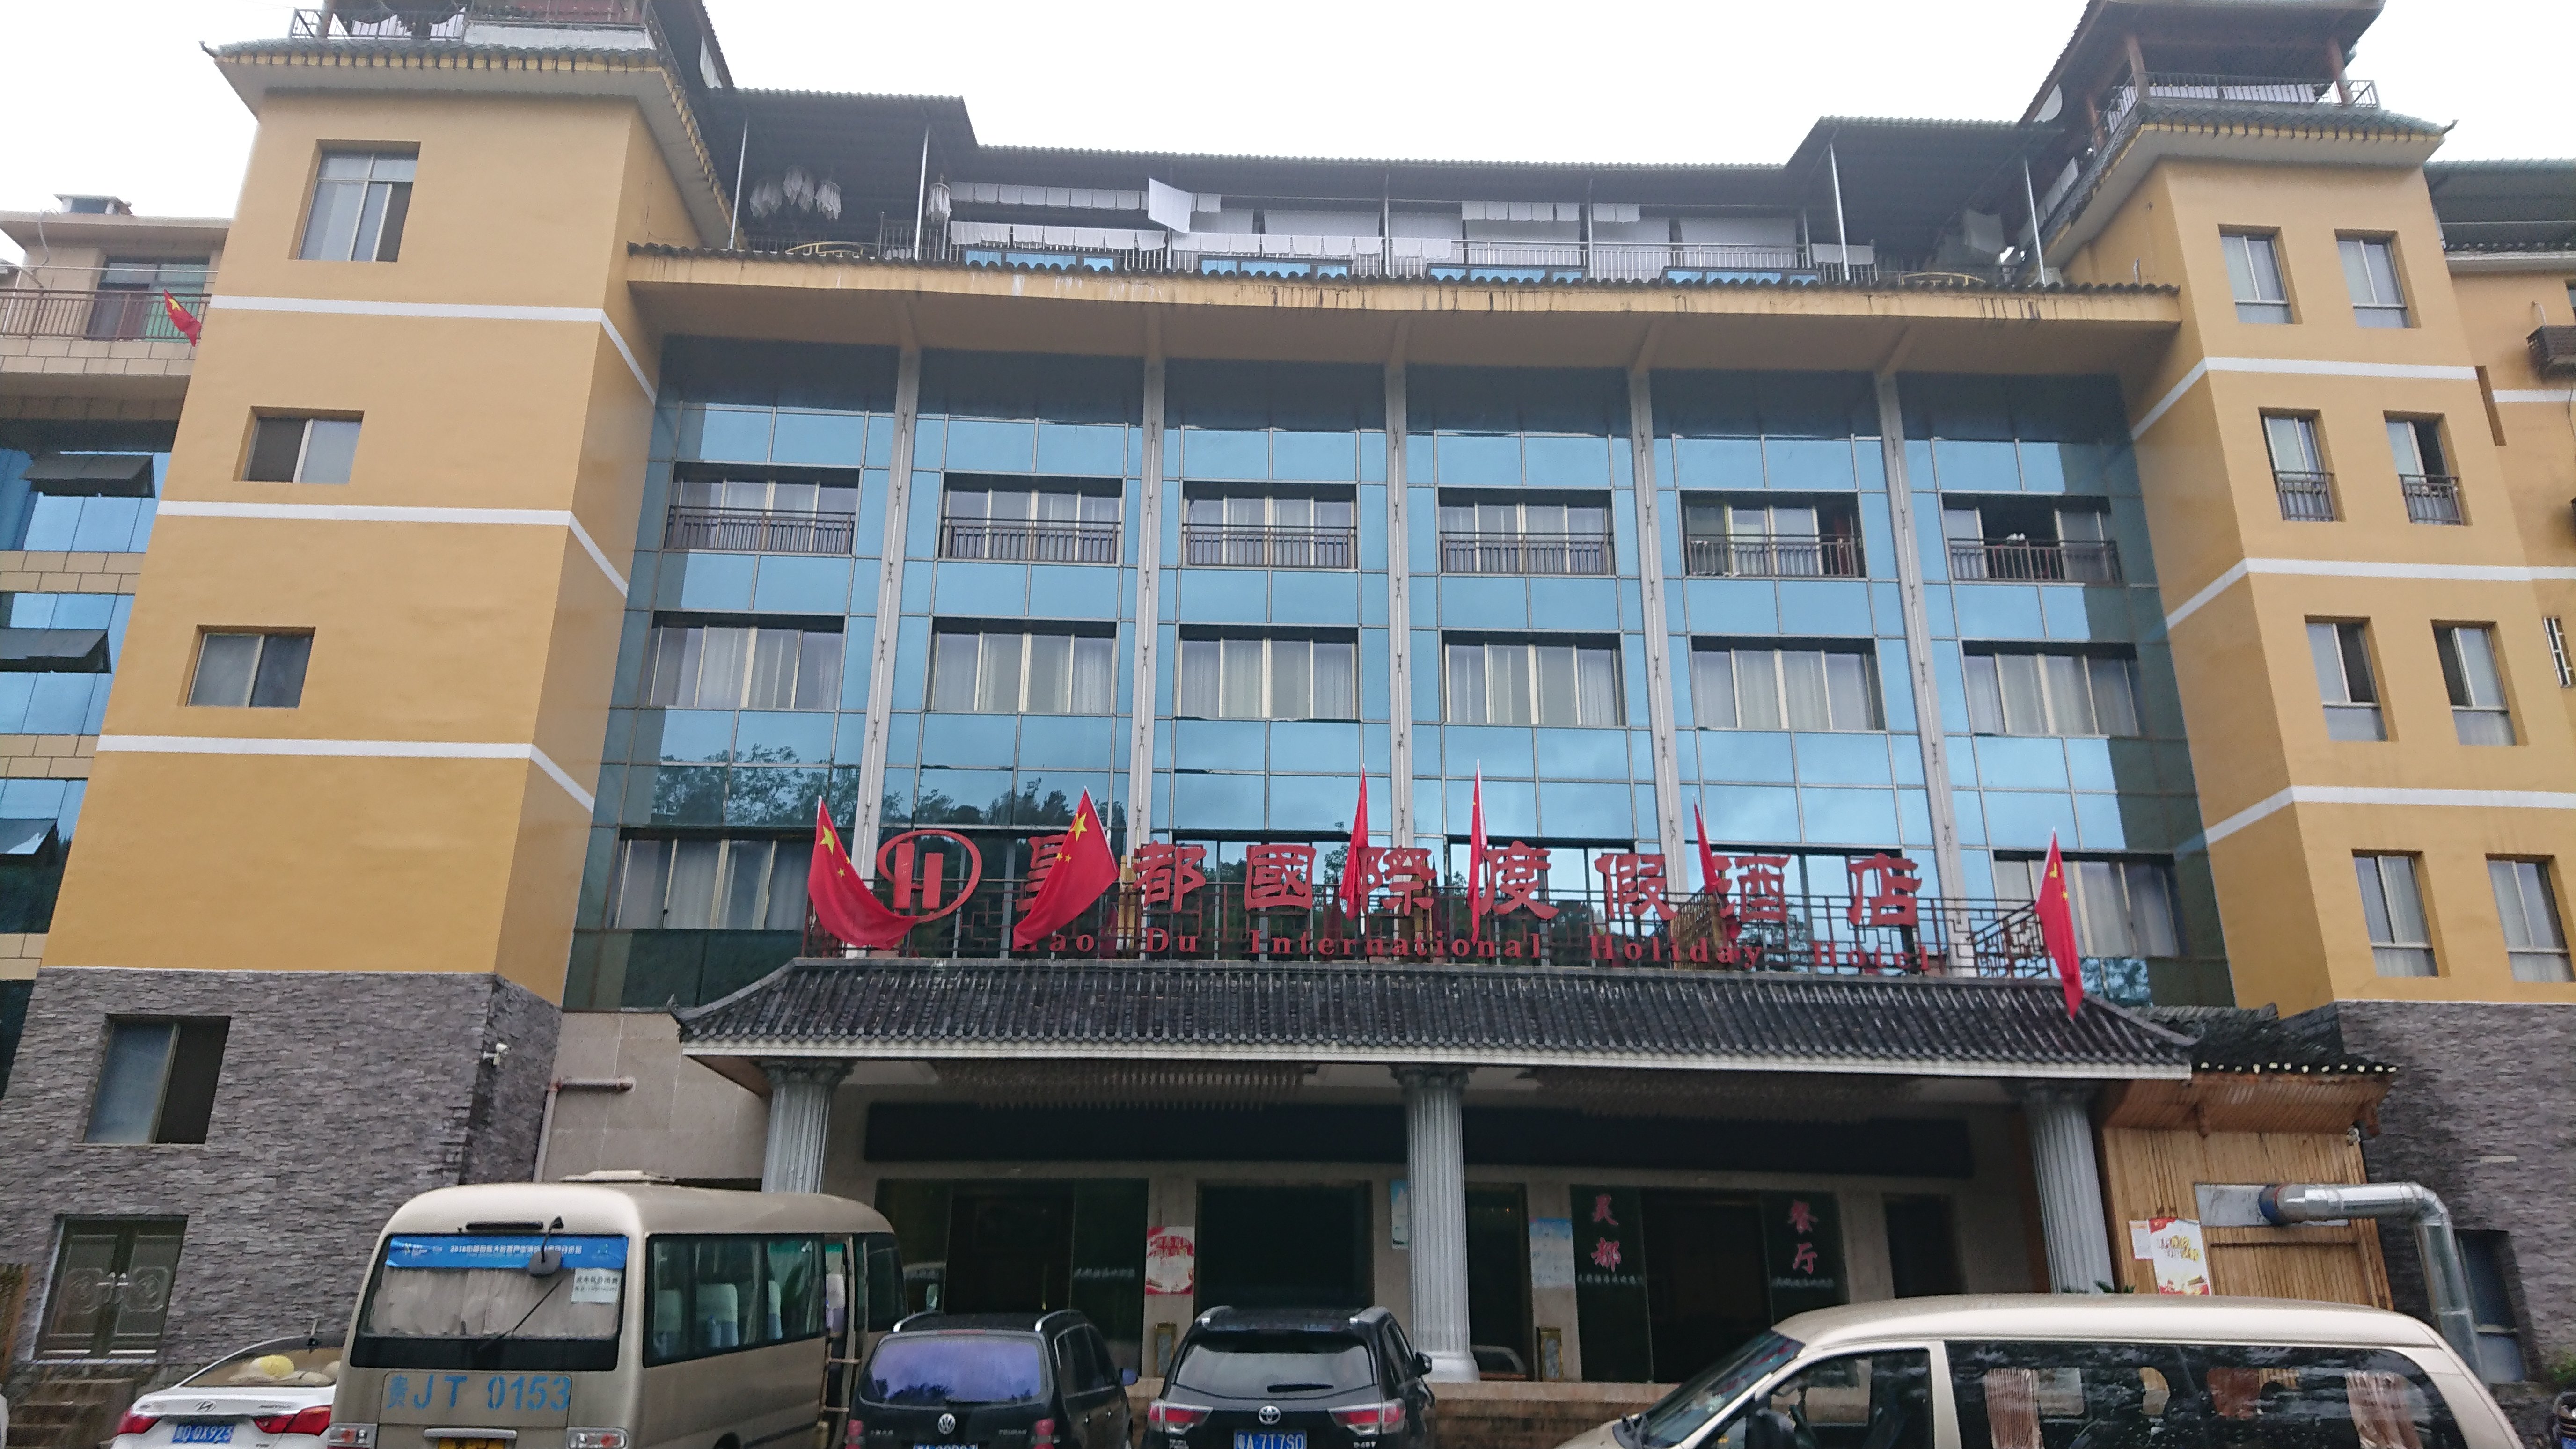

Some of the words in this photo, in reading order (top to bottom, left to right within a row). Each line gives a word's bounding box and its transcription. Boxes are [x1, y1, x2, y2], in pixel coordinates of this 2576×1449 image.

[1145, 927, 1198, 953] Du
[1249, 929, 1541, 959] International
[1589, 935, 1763, 969] Holiday
[1812, 940, 1929, 971] Hotel
[1787, 1199, 1819, 1275] 餐厅
